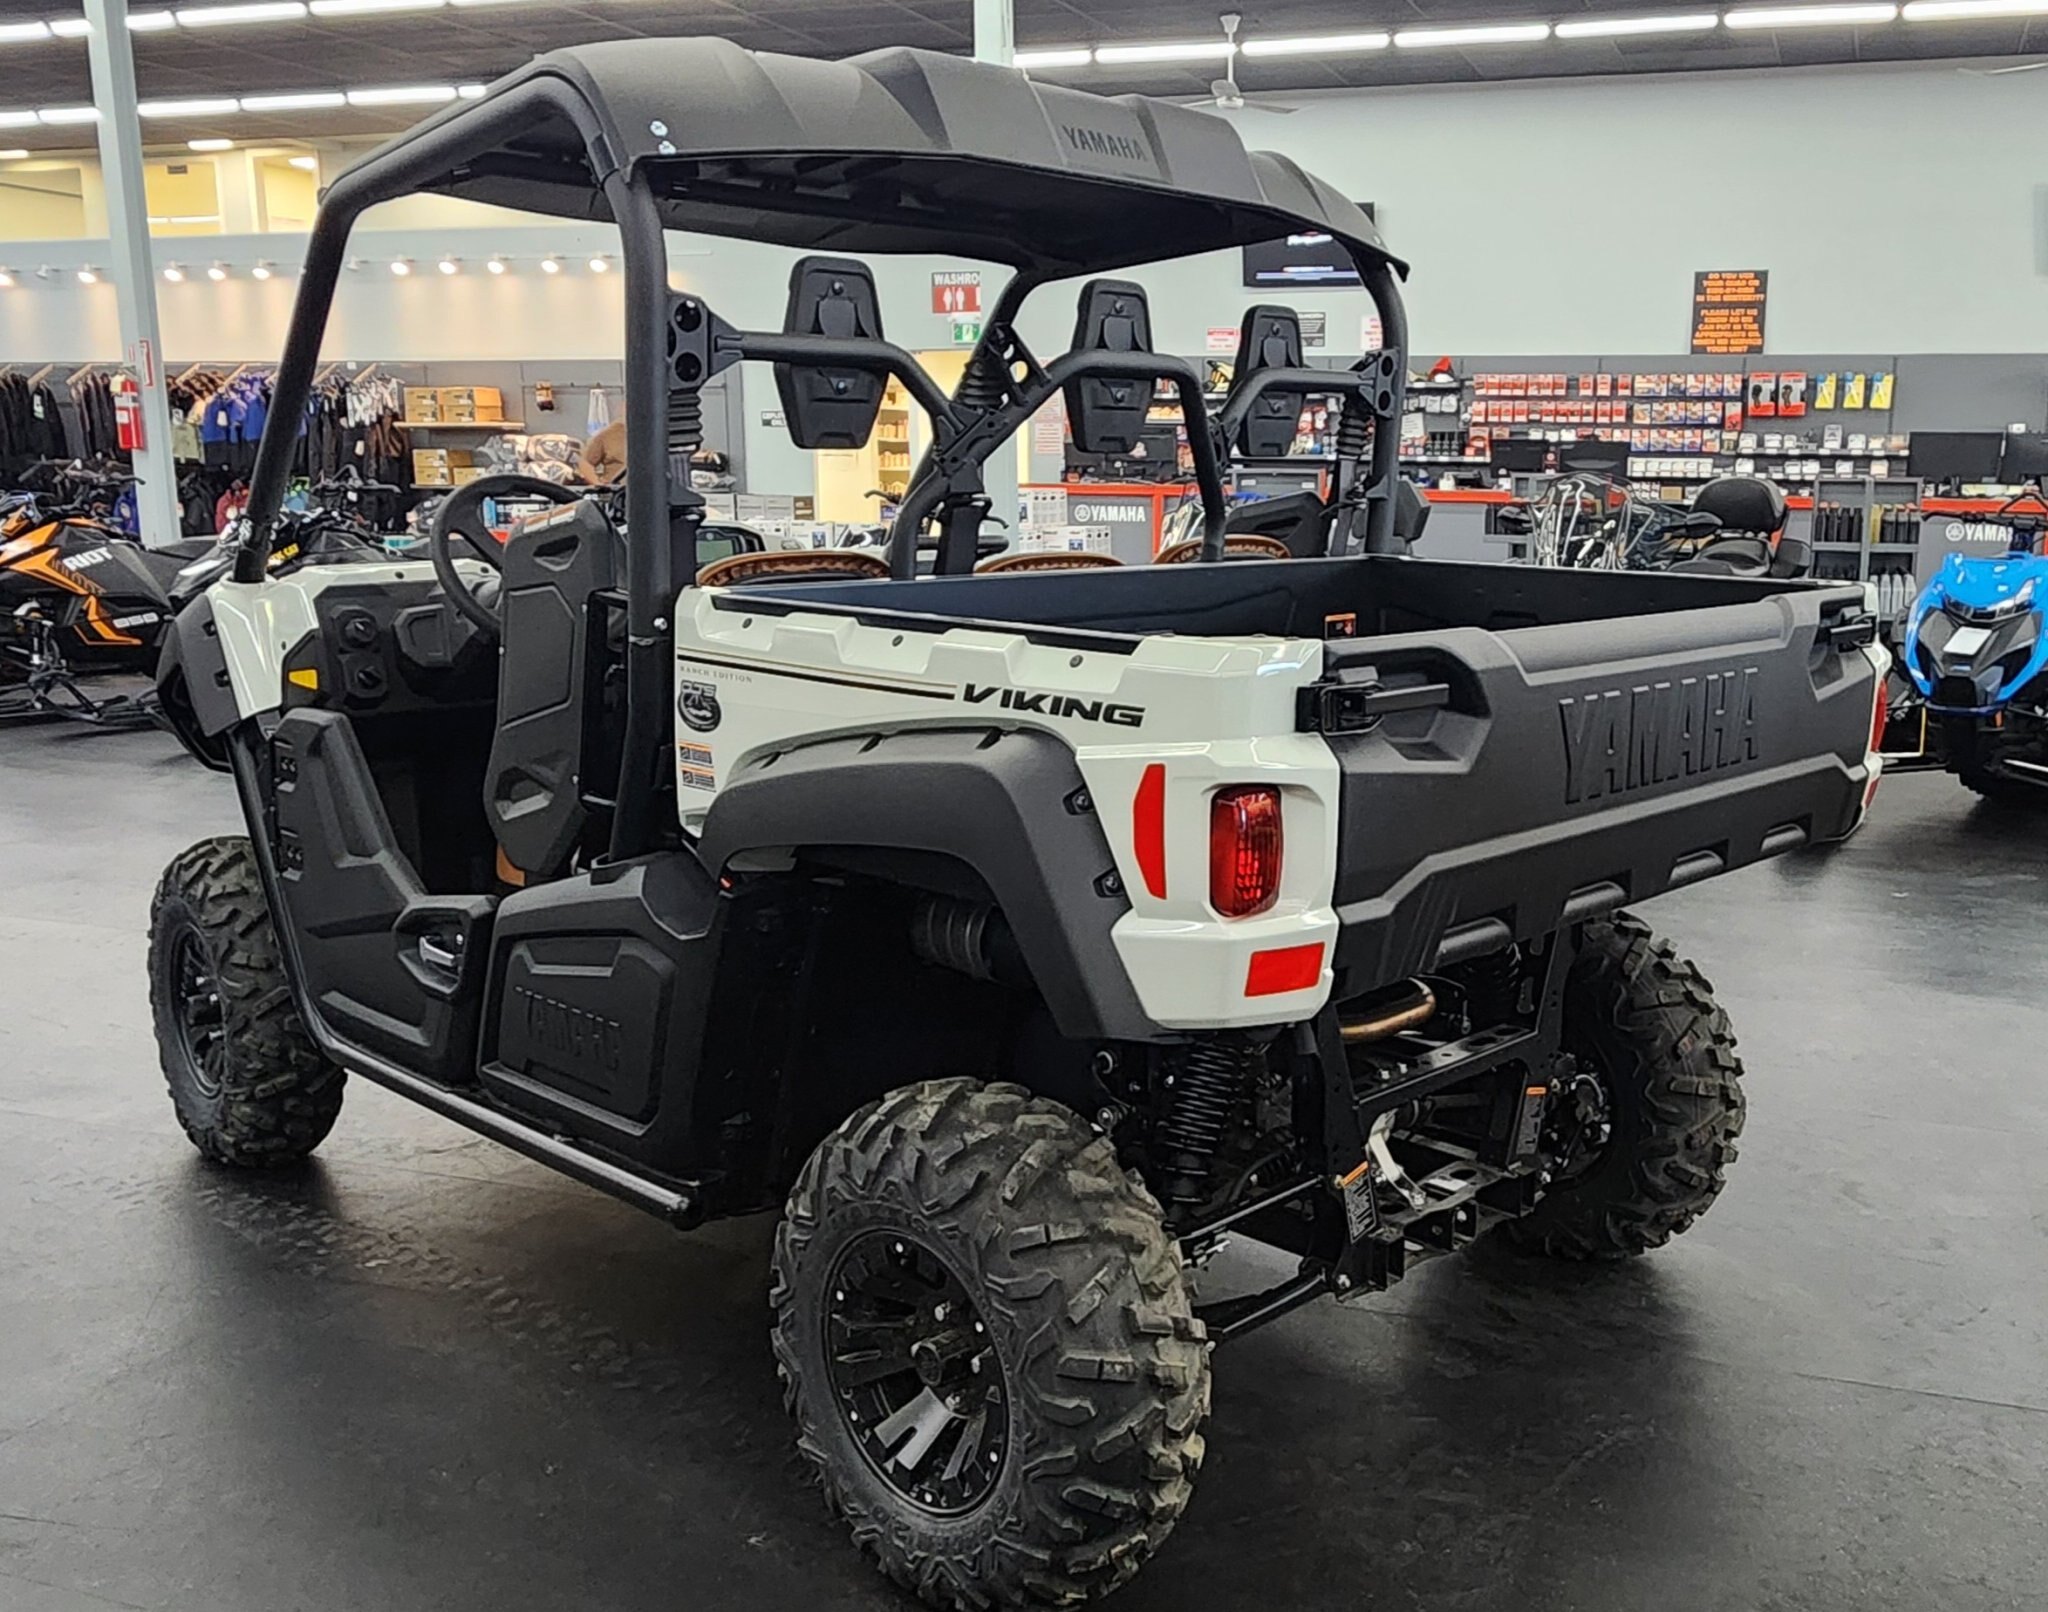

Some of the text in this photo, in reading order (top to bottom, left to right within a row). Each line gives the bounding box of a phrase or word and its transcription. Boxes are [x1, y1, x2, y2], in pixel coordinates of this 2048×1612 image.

[1062, 125, 1148, 162] YAMAHA
[934, 273, 979, 285] WASHRO
[1090, 505, 1146, 522] YAMAHA
[1965, 524, 2014, 541] YAMA
[62, 546, 113, 571] RIOT
[680, 666, 753, 684] RANCH EDITION
[962, 683, 1146, 728] VIKING
[1557, 666, 1759, 805] YAMAHA
